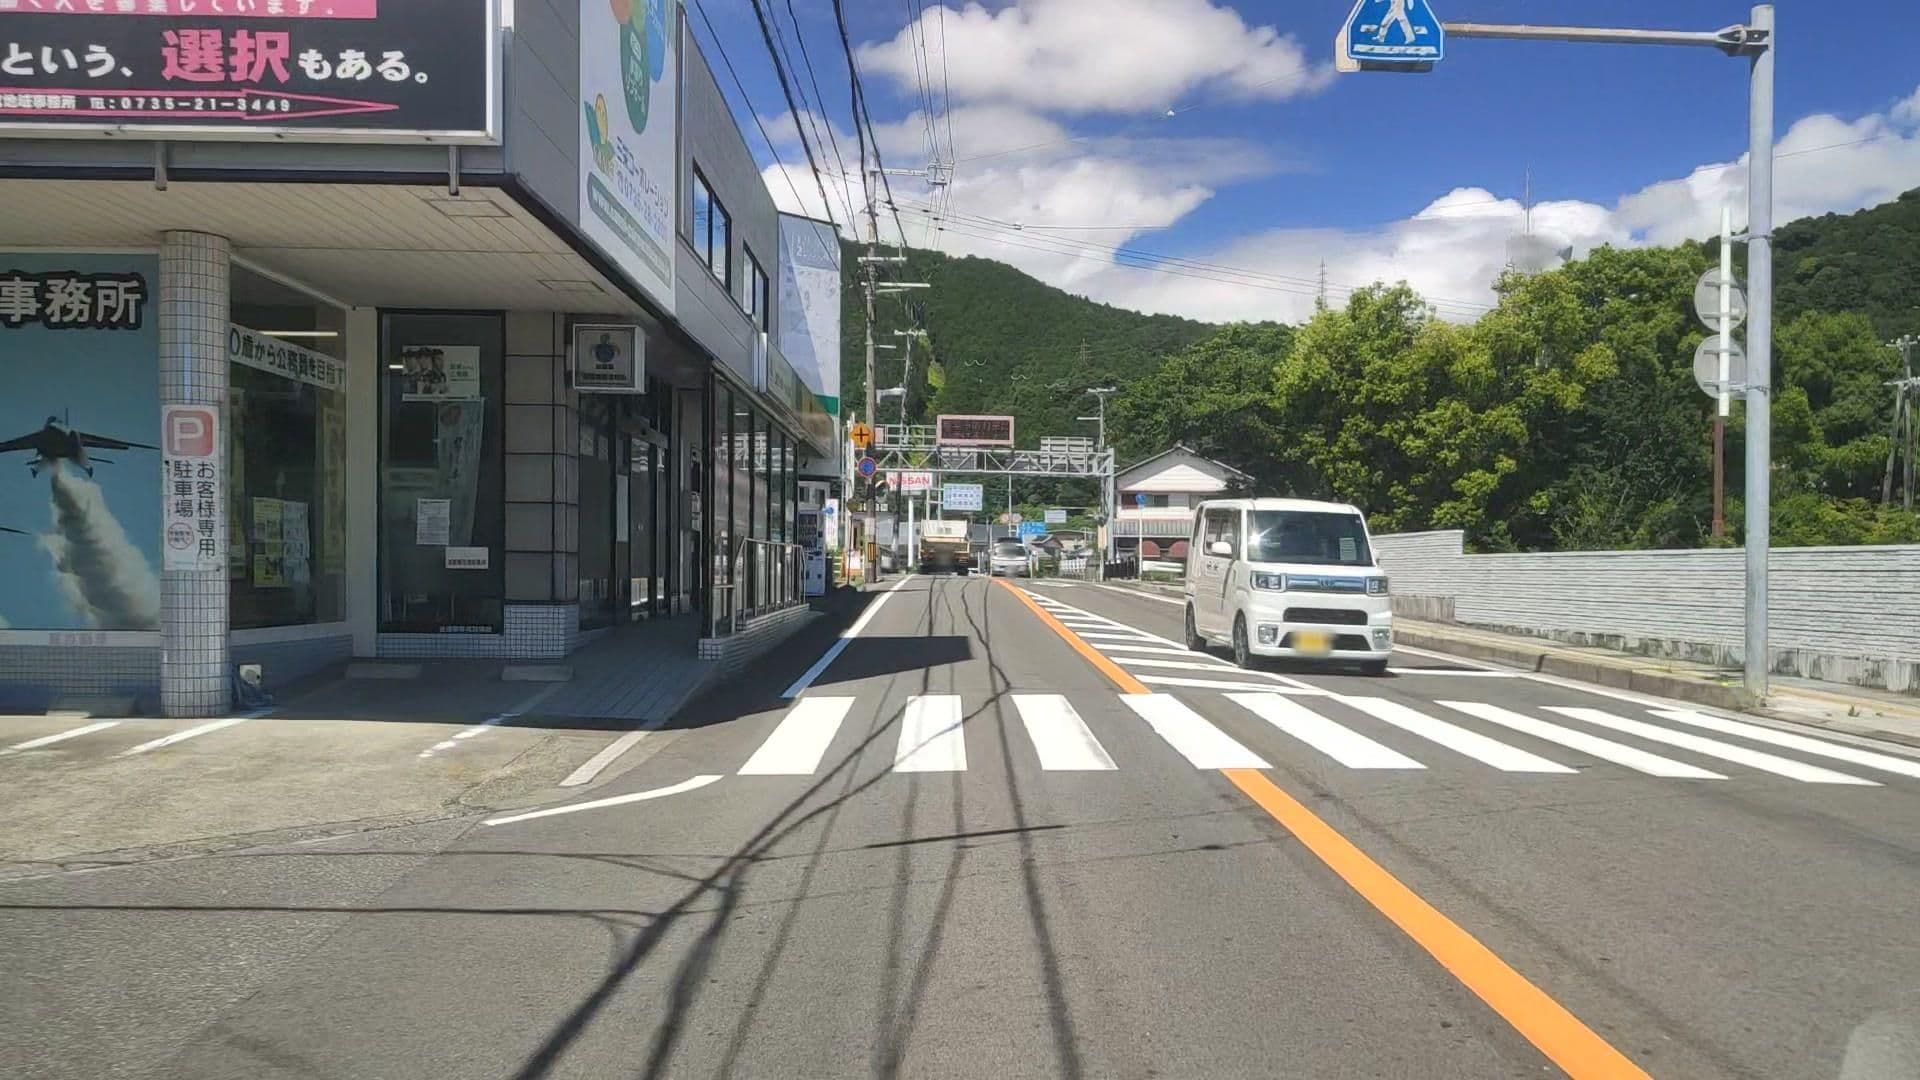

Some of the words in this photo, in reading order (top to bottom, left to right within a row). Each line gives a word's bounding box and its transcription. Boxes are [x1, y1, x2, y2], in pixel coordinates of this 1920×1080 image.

[0, 276, 142, 324] 事務所
[173, 417, 204, 451] P
[174, 460, 194, 518] 駐車場
[889, 474, 930, 486] NSSAN
[197, 462, 216, 557] お客様専用
